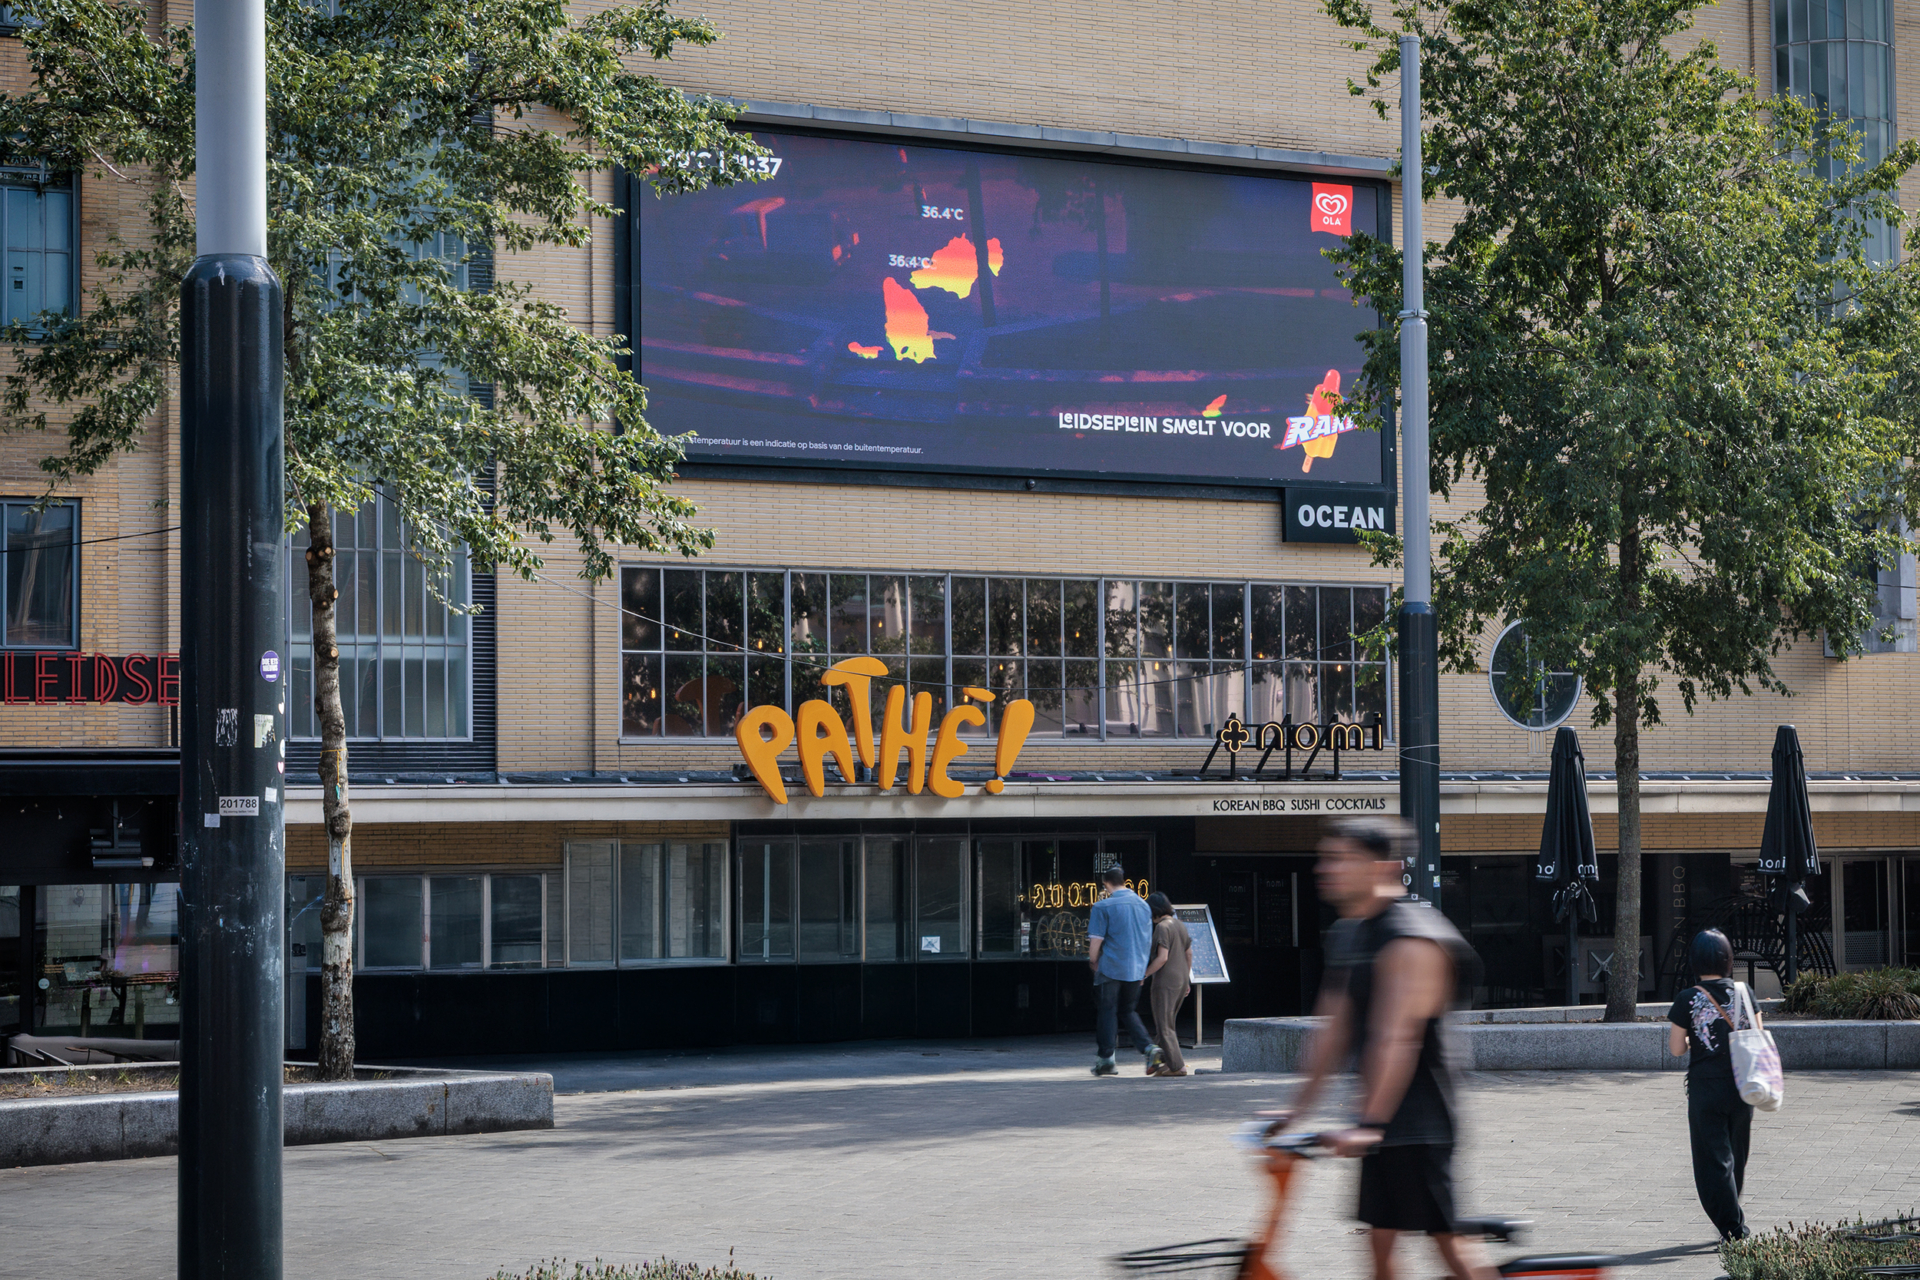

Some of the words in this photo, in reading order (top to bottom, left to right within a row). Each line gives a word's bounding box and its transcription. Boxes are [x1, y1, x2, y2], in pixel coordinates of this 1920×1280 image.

[1322, 216, 1342, 226] OLA
[1221, 420, 1272, 439] VOOR
[742, 437, 749, 447] is
[749, 440, 764, 448] een
[765, 438, 797, 449] indicatie
[797, 441, 808, 451] op
[808, 441, 828, 450] basis
[829, 443, 843, 451] van
[843, 442, 854, 451] de
[1298, 504, 1385, 529] OCEAN
[1256, 711, 1384, 751] nomi
[220, 799, 257, 809] 201788
[1213, 799, 1260, 811] KOREAN
[1262, 799, 1286, 811] BBQ
[1290, 799, 1320, 811] SUSHI
[1325, 798, 1386, 811] COCKTAILS
[1672, 865, 1687, 908] BBQ
